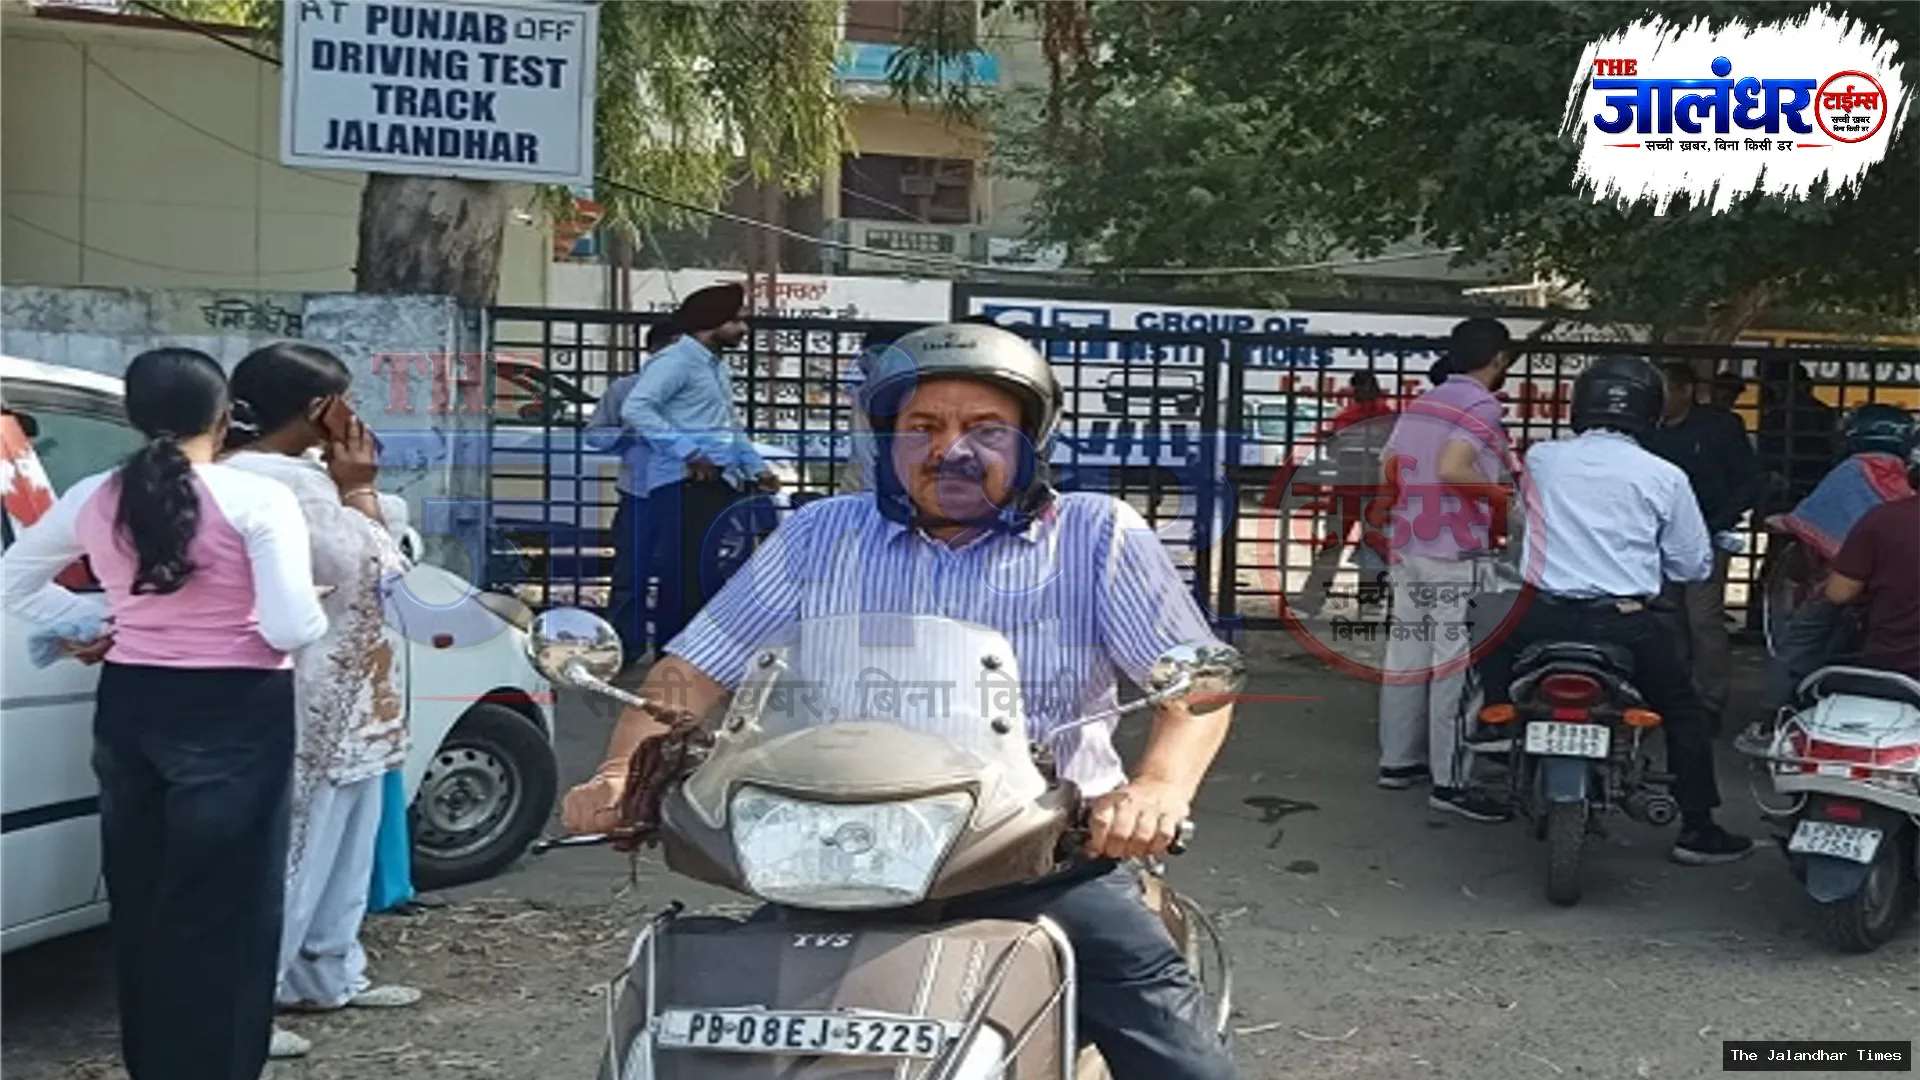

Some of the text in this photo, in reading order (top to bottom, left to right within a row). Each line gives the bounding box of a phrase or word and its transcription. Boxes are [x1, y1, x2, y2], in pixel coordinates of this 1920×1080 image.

[366, 5, 507, 44] PUNJAB
[312, 39, 567, 88] DRIVING TEST
[371, 83, 497, 123] TRACK
[324, 119, 539, 164] JALANDHAR
[1135, 312, 1254, 334] GROUP
[793, 932, 853, 948] TVS
